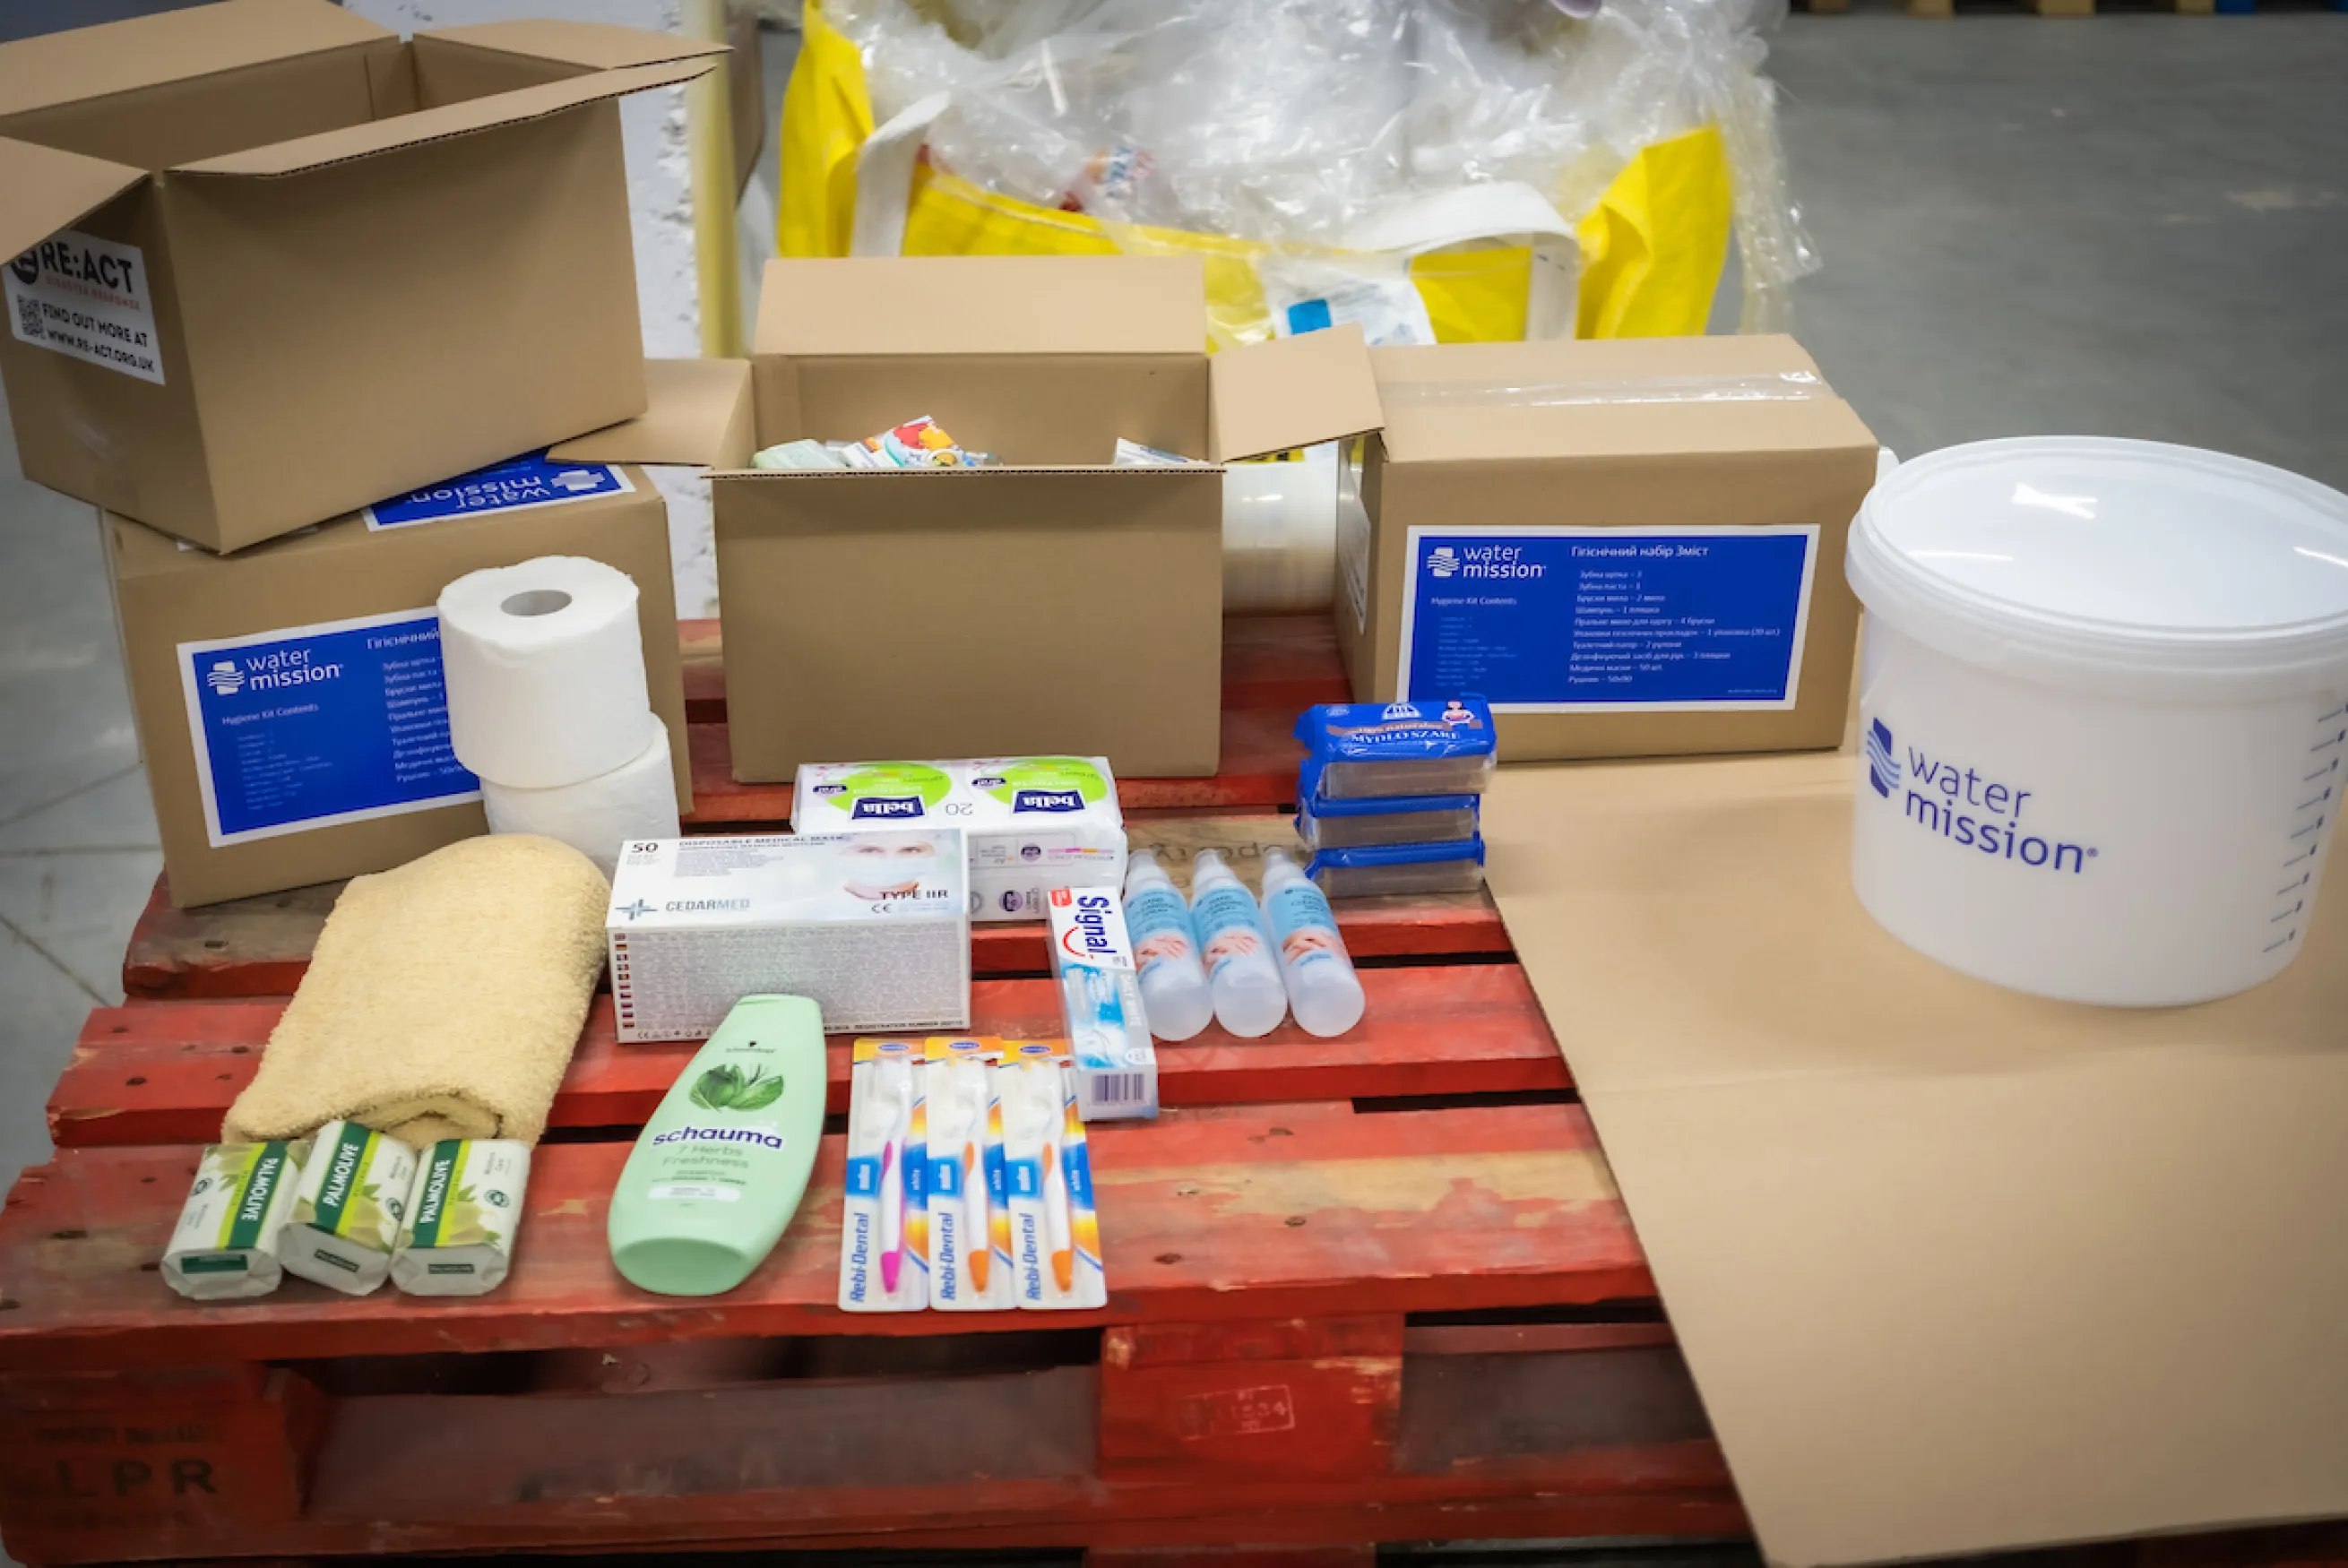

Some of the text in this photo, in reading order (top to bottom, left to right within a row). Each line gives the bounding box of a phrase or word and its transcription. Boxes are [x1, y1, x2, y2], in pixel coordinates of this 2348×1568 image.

[42, 241, 133, 293] RE:ACT
[42, 303, 147, 348] FIND OUT MORE AT
[1463, 545, 1522, 561] water
[246, 648, 311, 673] water
[222, 703, 318, 726] Hygiene Kit Contents
[1908, 745, 2032, 818] water
[863, 802, 914, 814] bella
[1022, 796, 1075, 808] bella
[633, 842, 659, 853] 50
[665, 899, 751, 913] CEDARMED
[878, 890, 921, 900] TYPE
[1075, 895, 1118, 954] Signal
[652, 1125, 782, 1149] schauma
[662, 1155, 748, 1168] Freshness
[691, 1145, 743, 1157] Herbs
[322, 1142, 360, 1208] PALMOLIVE
[240, 1157, 280, 1222] PALMOLIVE
[419, 1159, 452, 1225] PALMOLIVE
[849, 1212, 868, 1302] Rebi-Dental
[939, 1212, 954, 1300] Rebi-Dental
[1019, 1212, 1041, 1300] Rebi-Dental
